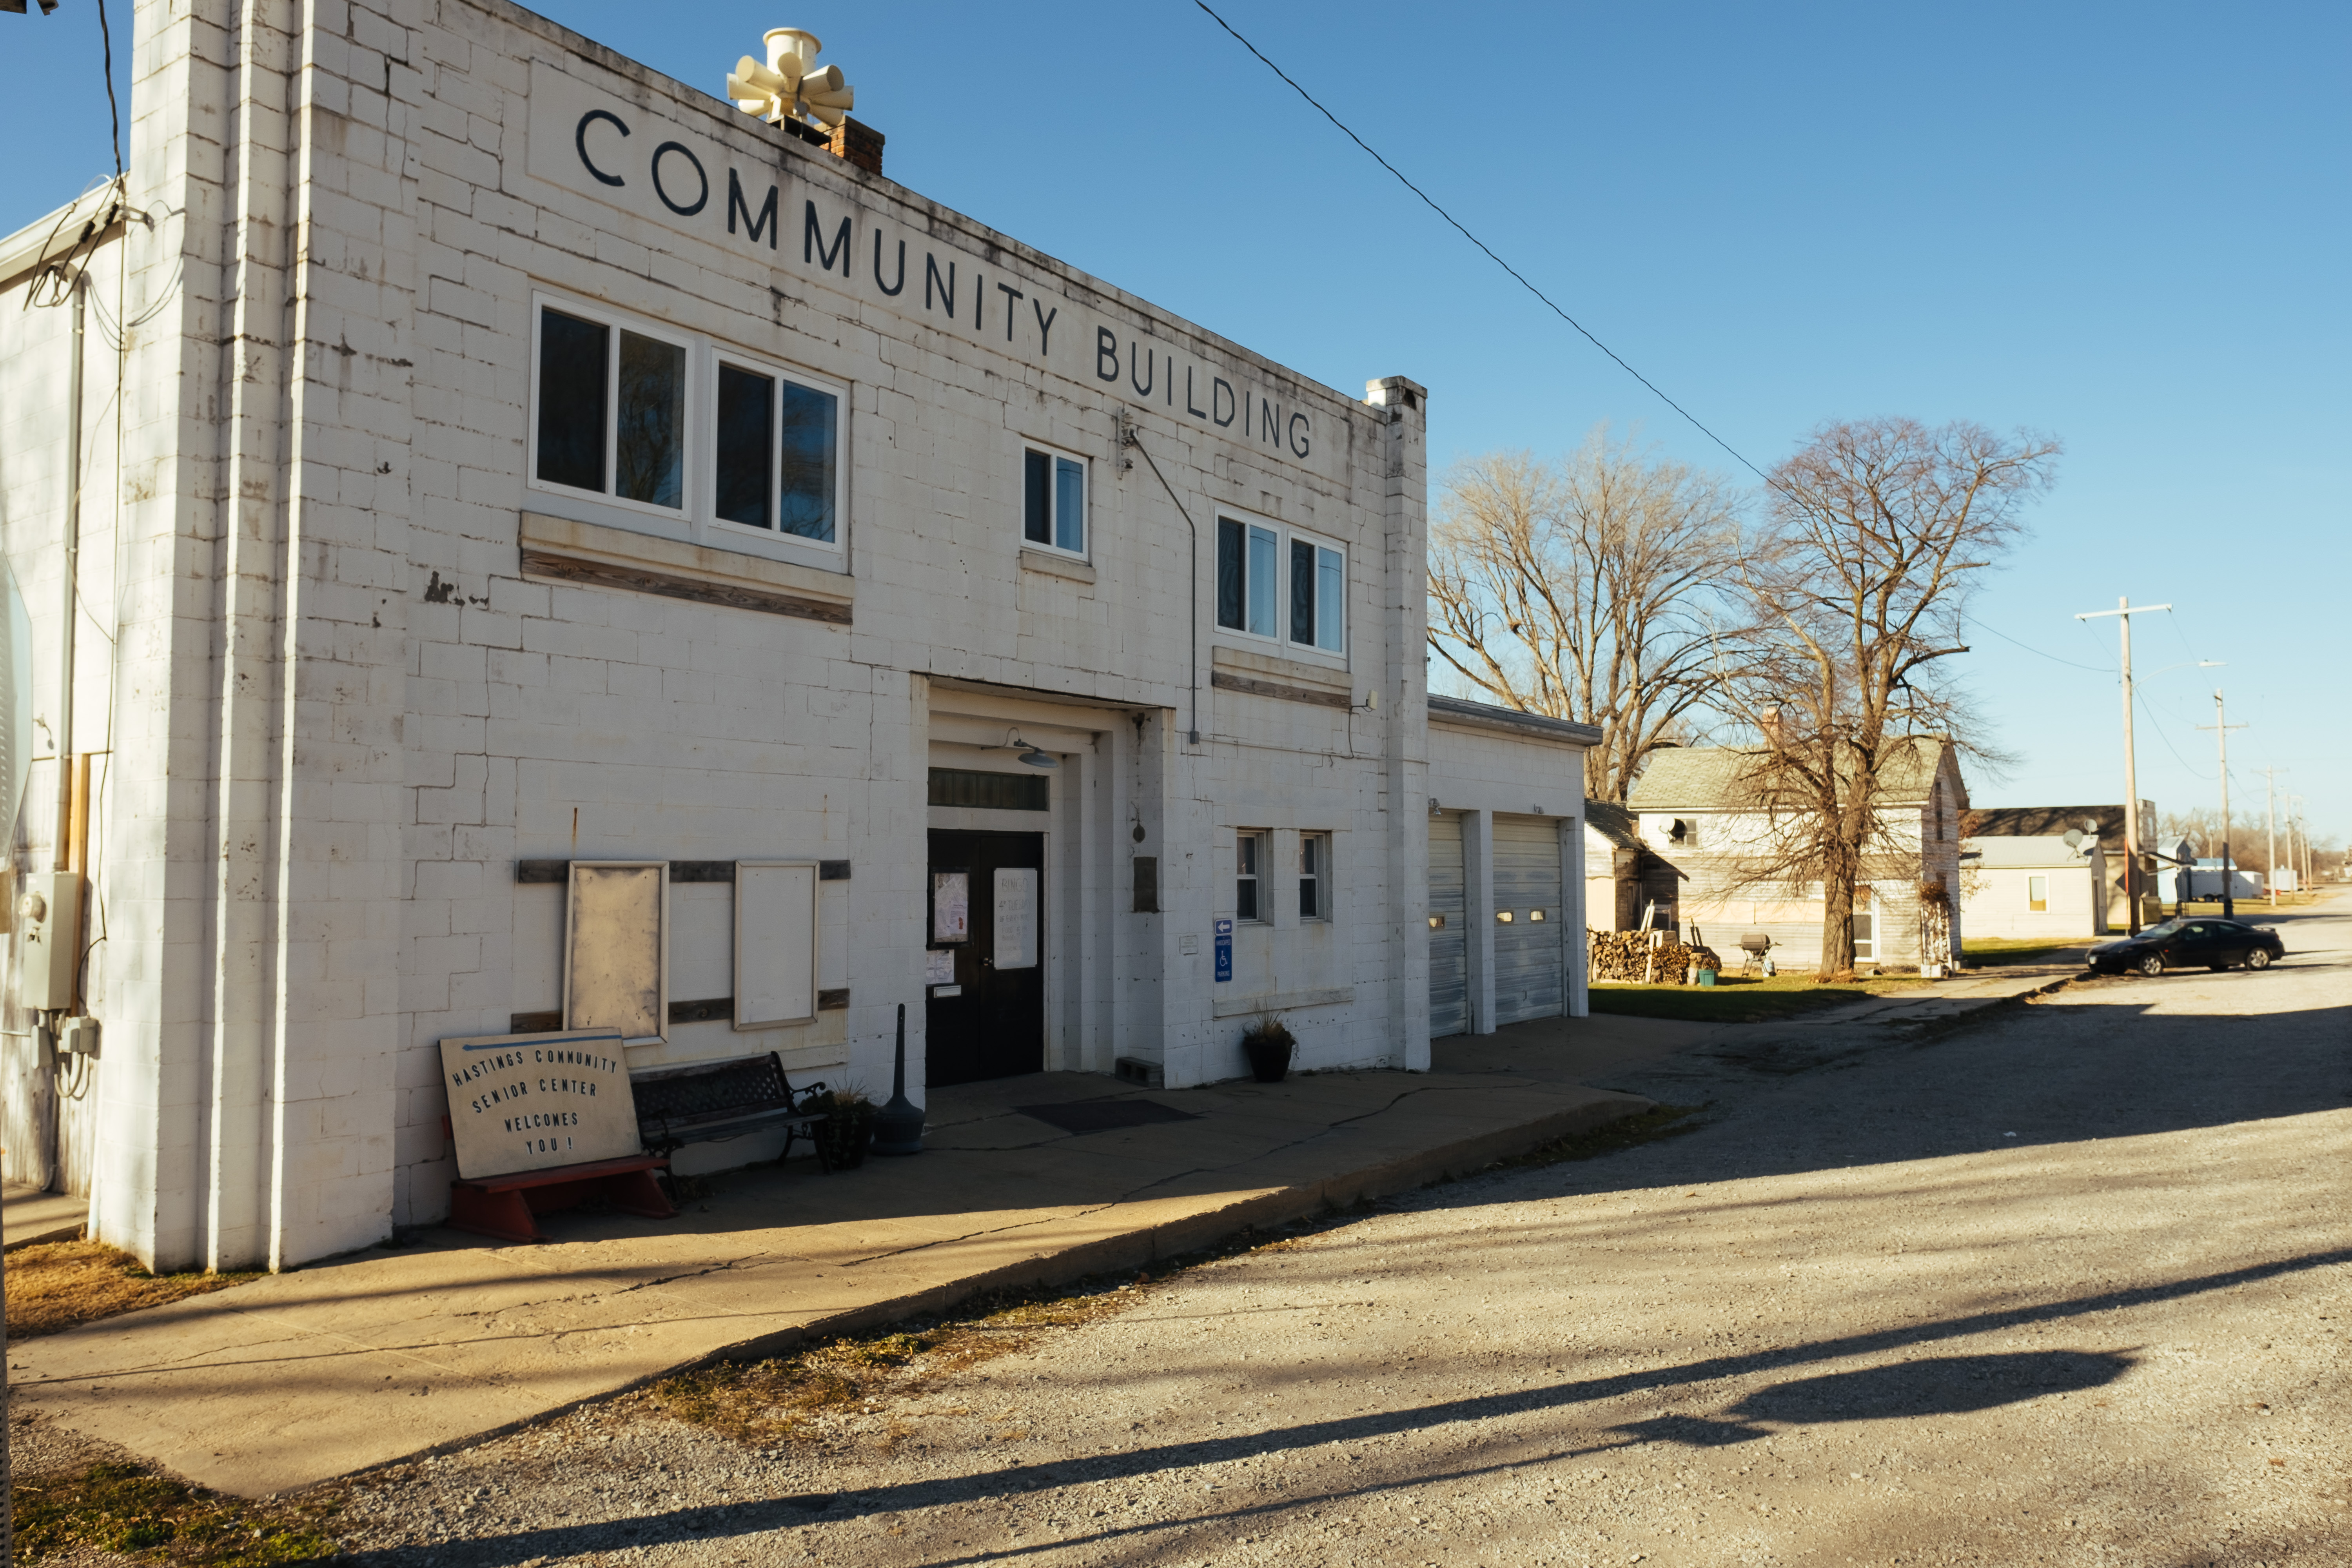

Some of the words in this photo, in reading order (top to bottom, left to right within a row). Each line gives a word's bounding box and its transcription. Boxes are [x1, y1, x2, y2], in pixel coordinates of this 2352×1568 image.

[575, 109, 1058, 356] COMMUNITY
[1096, 325, 1310, 459] BUILDING
[1002, 878, 1029, 893] BINGO
[452, 1051, 523, 1087] HASTINGS
[535, 1050, 616, 1073] COMMUNITY
[472, 1082, 528, 1113] SENIOR
[539, 1079, 595, 1096] CENTER
[505, 1112, 578, 1132] WELCOMES
